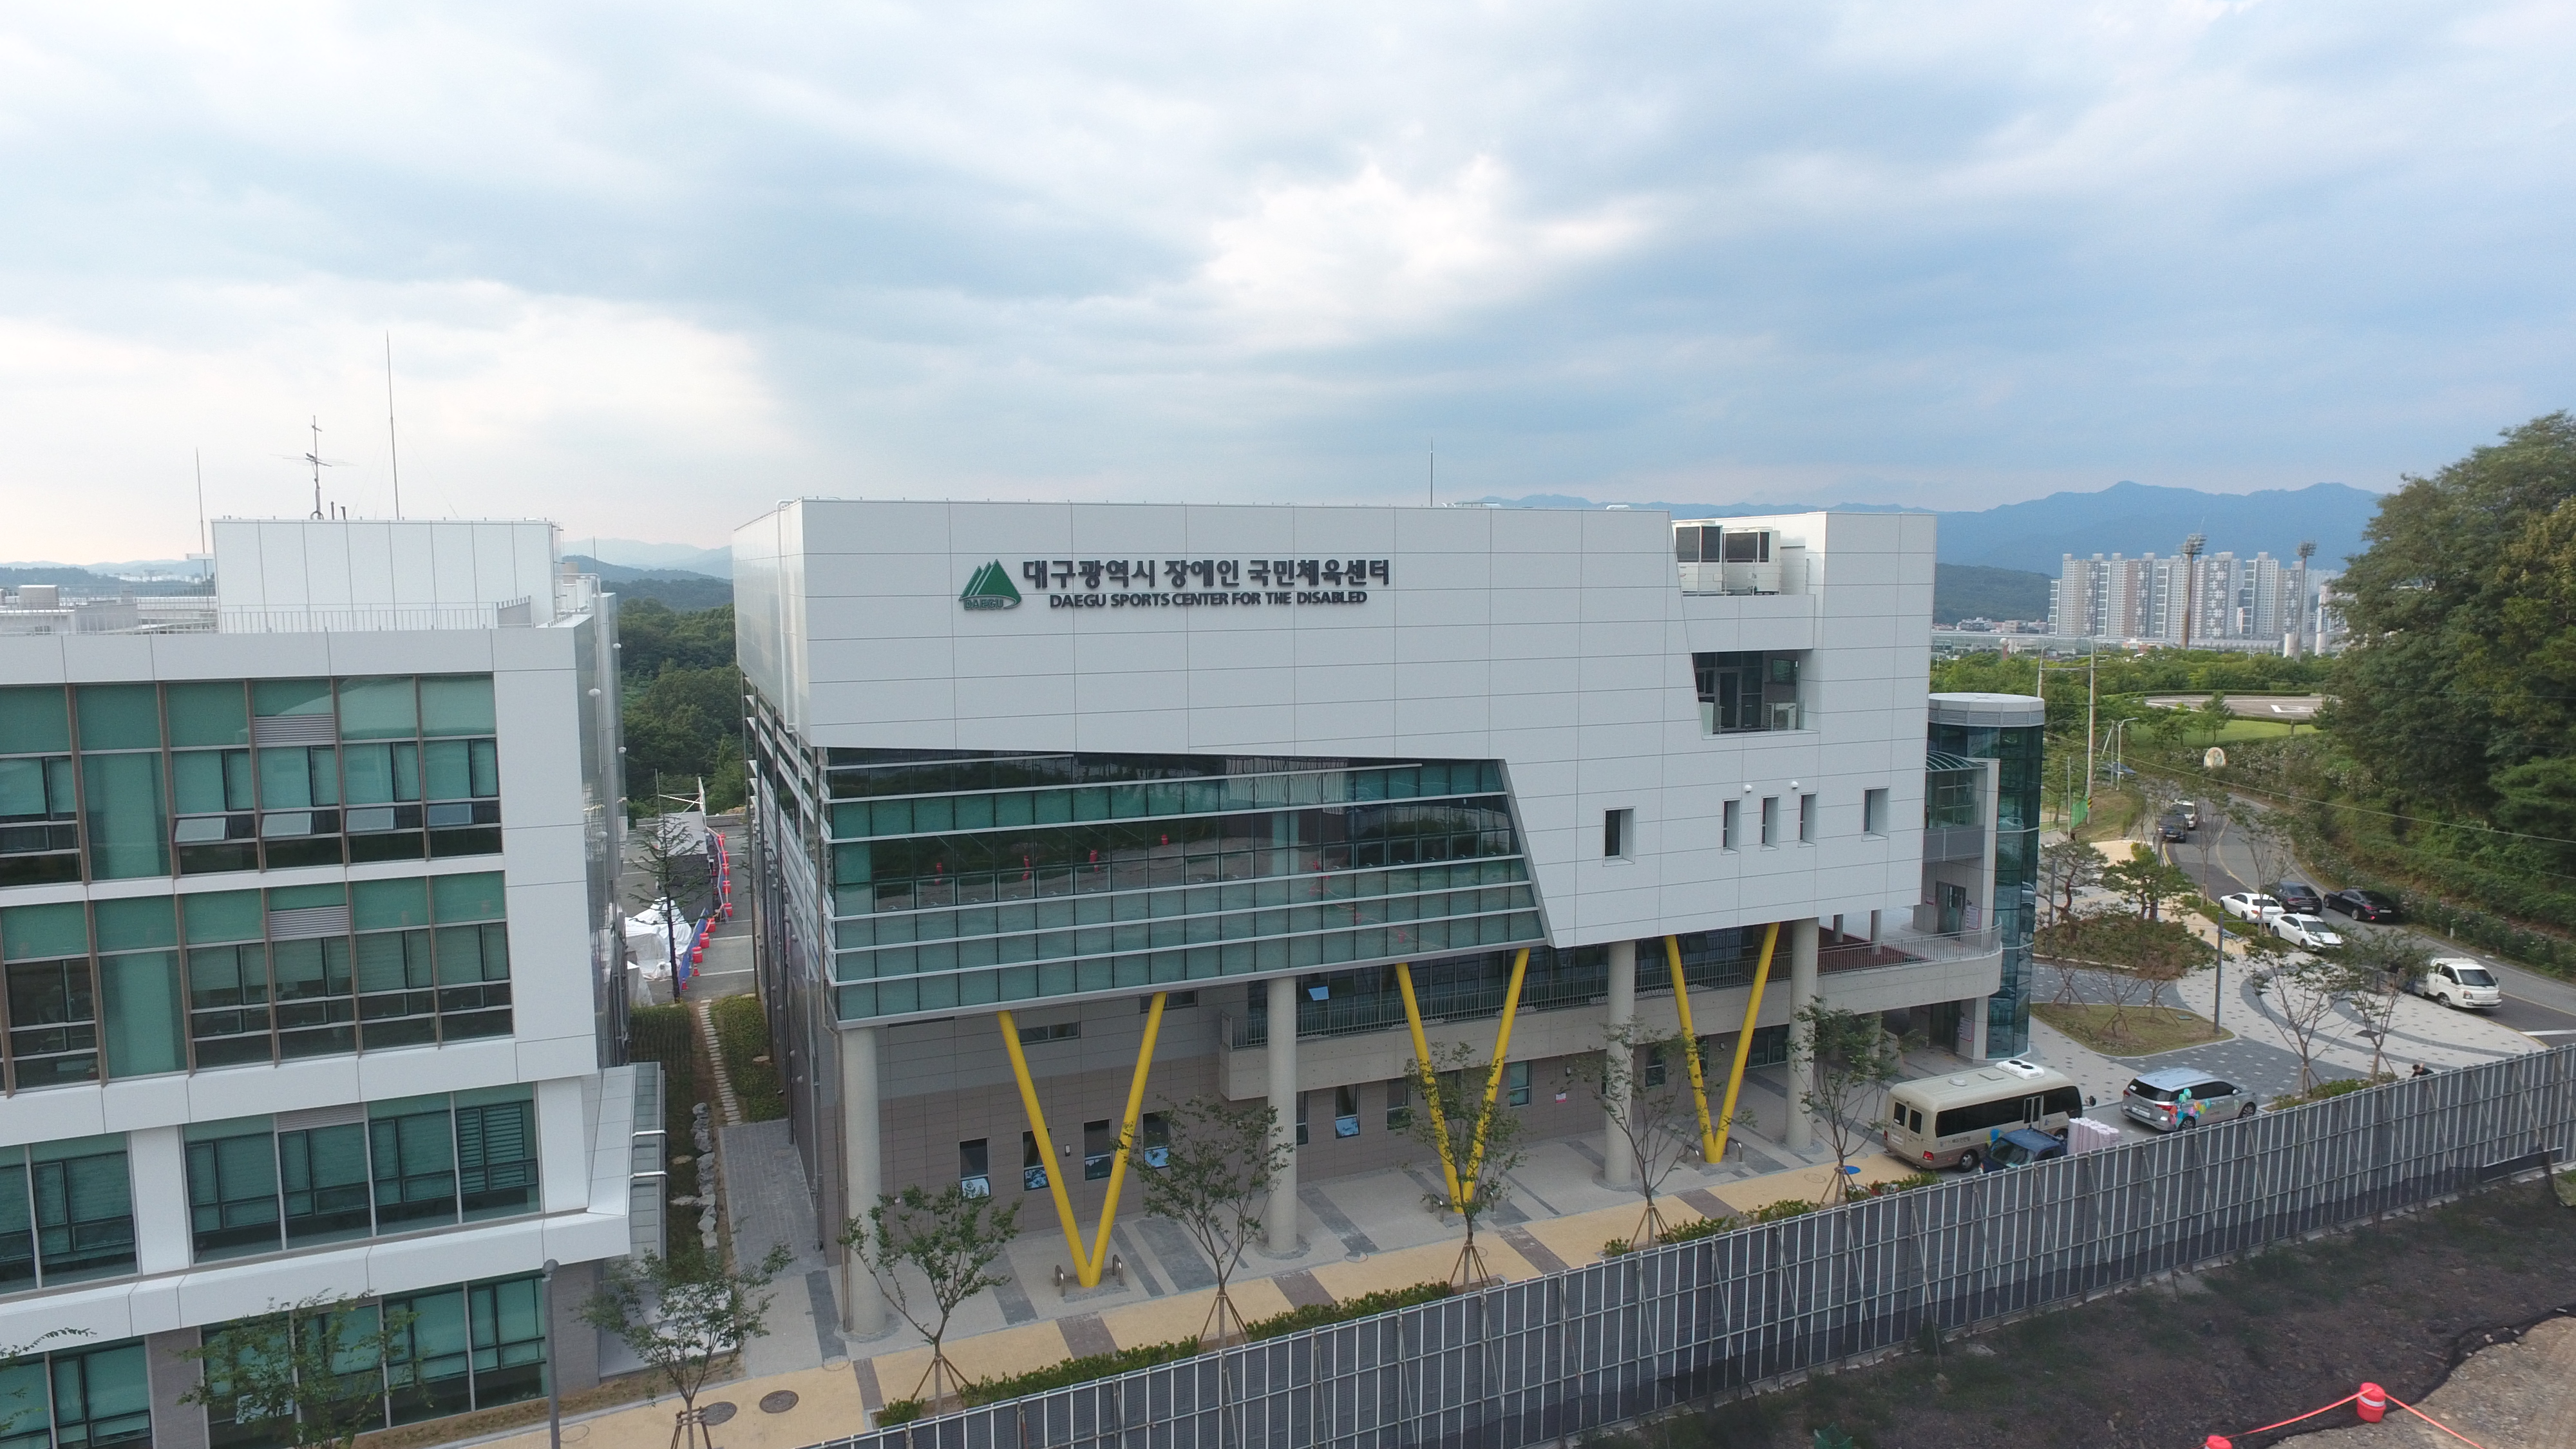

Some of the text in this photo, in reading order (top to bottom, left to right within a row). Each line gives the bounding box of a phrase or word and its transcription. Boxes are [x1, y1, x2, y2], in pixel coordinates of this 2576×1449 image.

[1023, 559, 1389, 589] 대구광역시 장애인 국민체육센터
[963, 598, 1004, 610] DAEGU
[1050, 591, 1367, 608] DAEGU SPORTS CENTER FOR THE DISABLED
